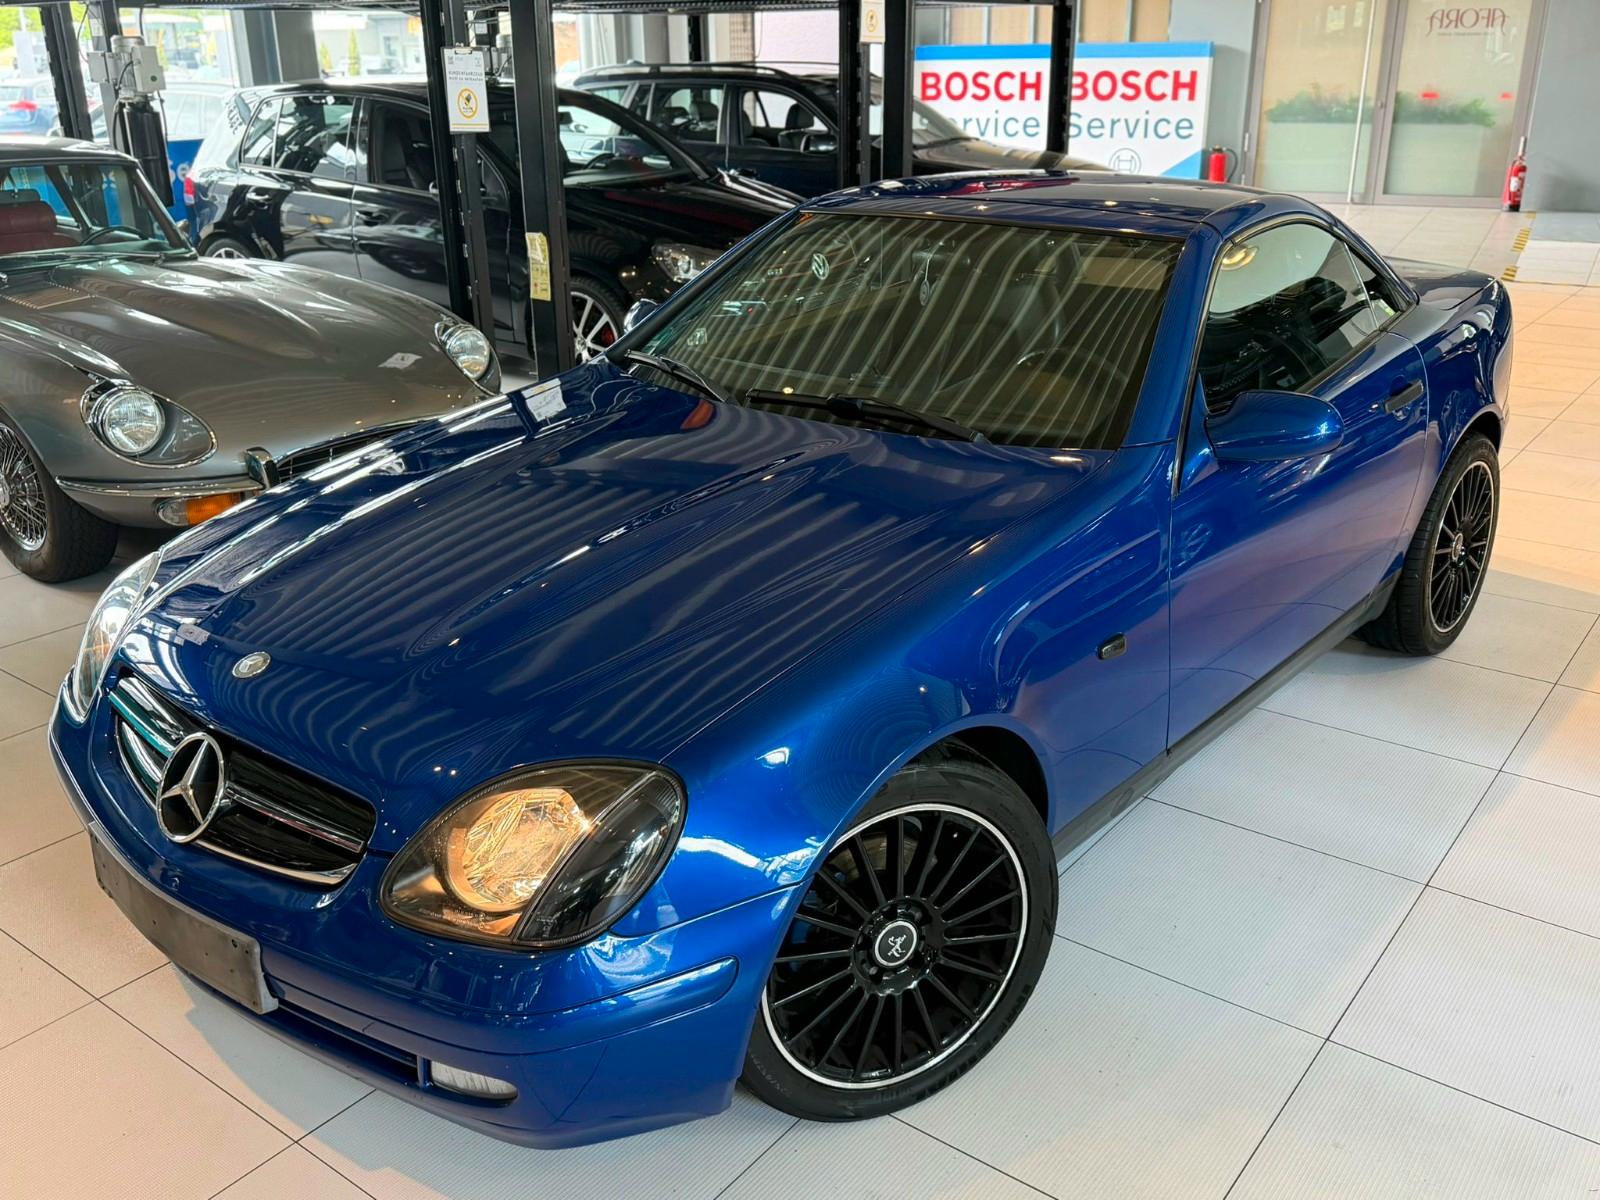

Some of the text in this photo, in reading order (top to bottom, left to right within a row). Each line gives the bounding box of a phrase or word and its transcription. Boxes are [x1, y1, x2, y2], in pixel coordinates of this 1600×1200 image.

[921, 71, 1042, 102] BOSCH
[1071, 70, 1198, 102] BOSCH
[949, 109, 1041, 138] rvice
[1069, 110, 1194, 140] Service
